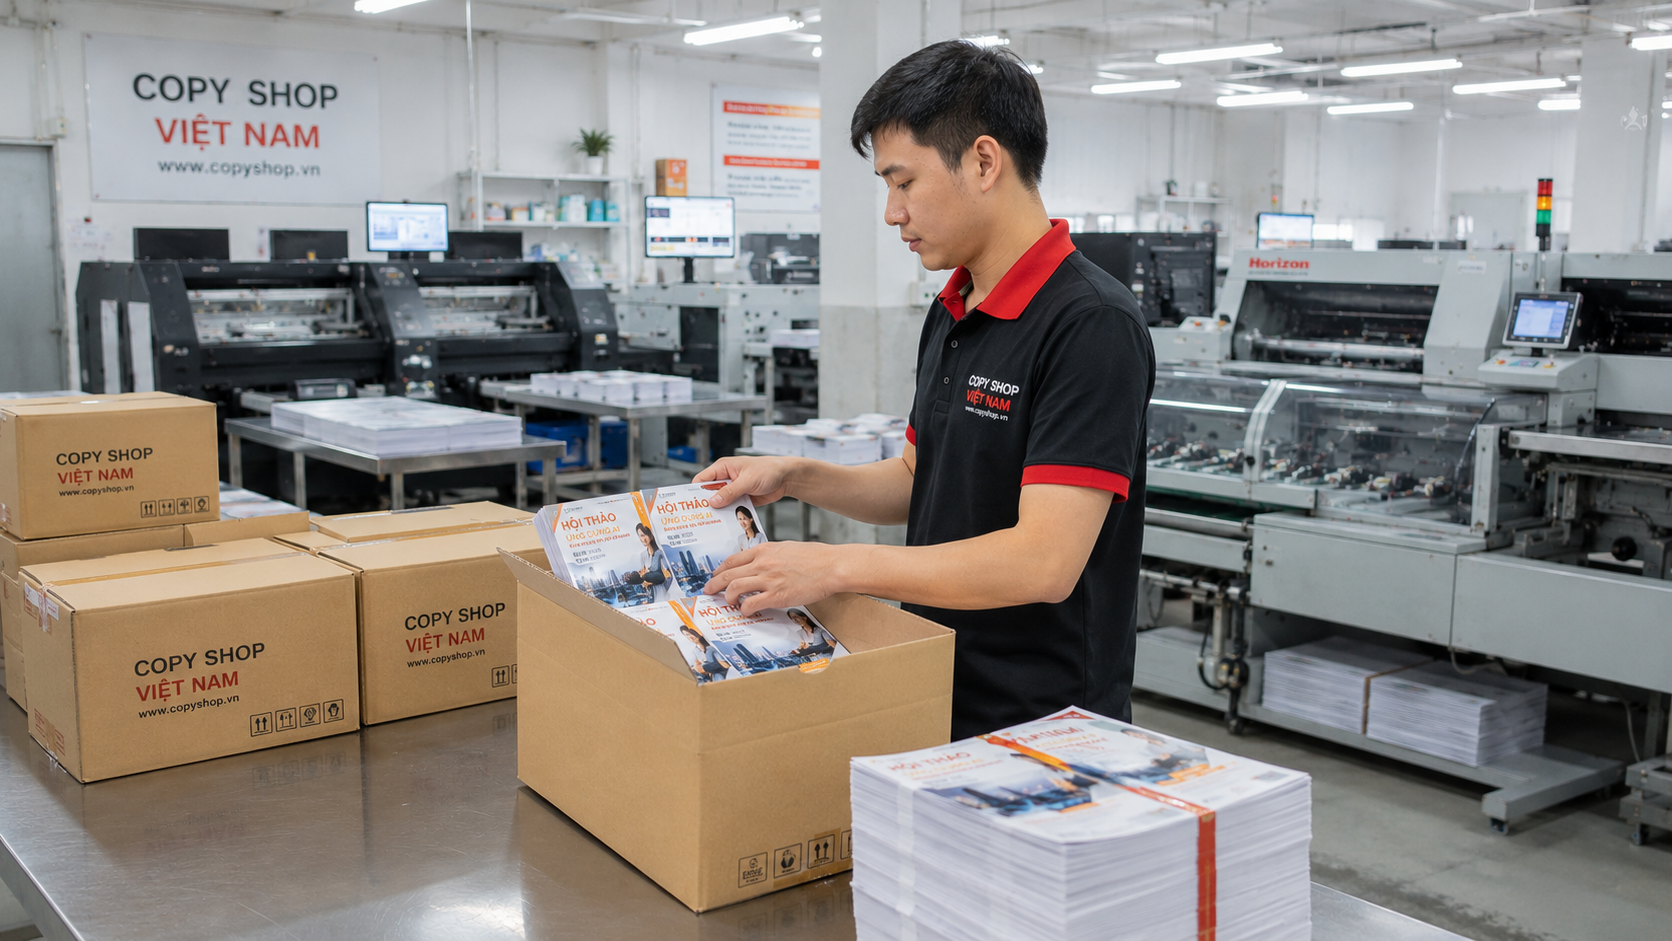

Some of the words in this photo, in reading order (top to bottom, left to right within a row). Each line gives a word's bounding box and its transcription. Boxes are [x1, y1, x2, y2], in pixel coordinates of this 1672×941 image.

[132, 73, 230, 104] COPY
[248, 79, 338, 109] SHOP
[155, 113, 232, 152] VIỆT
[244, 122, 320, 149] NAM
[158, 160, 321, 179] www.copyshop.vn
[1249, 257, 1310, 269] Horizon
[968, 375, 990, 389] COPY
[990, 380, 1019, 396] SHOP
[966, 388, 985, 405] VIỆT
[985, 395, 1011, 411] NAM
[56, 451, 102, 466] COPY
[108, 447, 153, 462] SHOP
[57, 468, 93, 486] VIỆT
[98, 467, 134, 482] NAM
[59, 484, 134, 497] www.copyshop.vn
[405, 610, 454, 631] COPY
[459, 602, 506, 623] SHOP
[406, 633, 443, 654] VIỆT
[449, 627, 485, 646] NAM
[134, 652, 197, 677] COPY
[204, 642, 266, 666] SHOP
[407, 649, 485, 668] www.copyshop.vn
[136, 678, 185, 702] VIỆT
[192, 671, 239, 693] NAM
[138, 693, 240, 719] www.copyshop.vn
